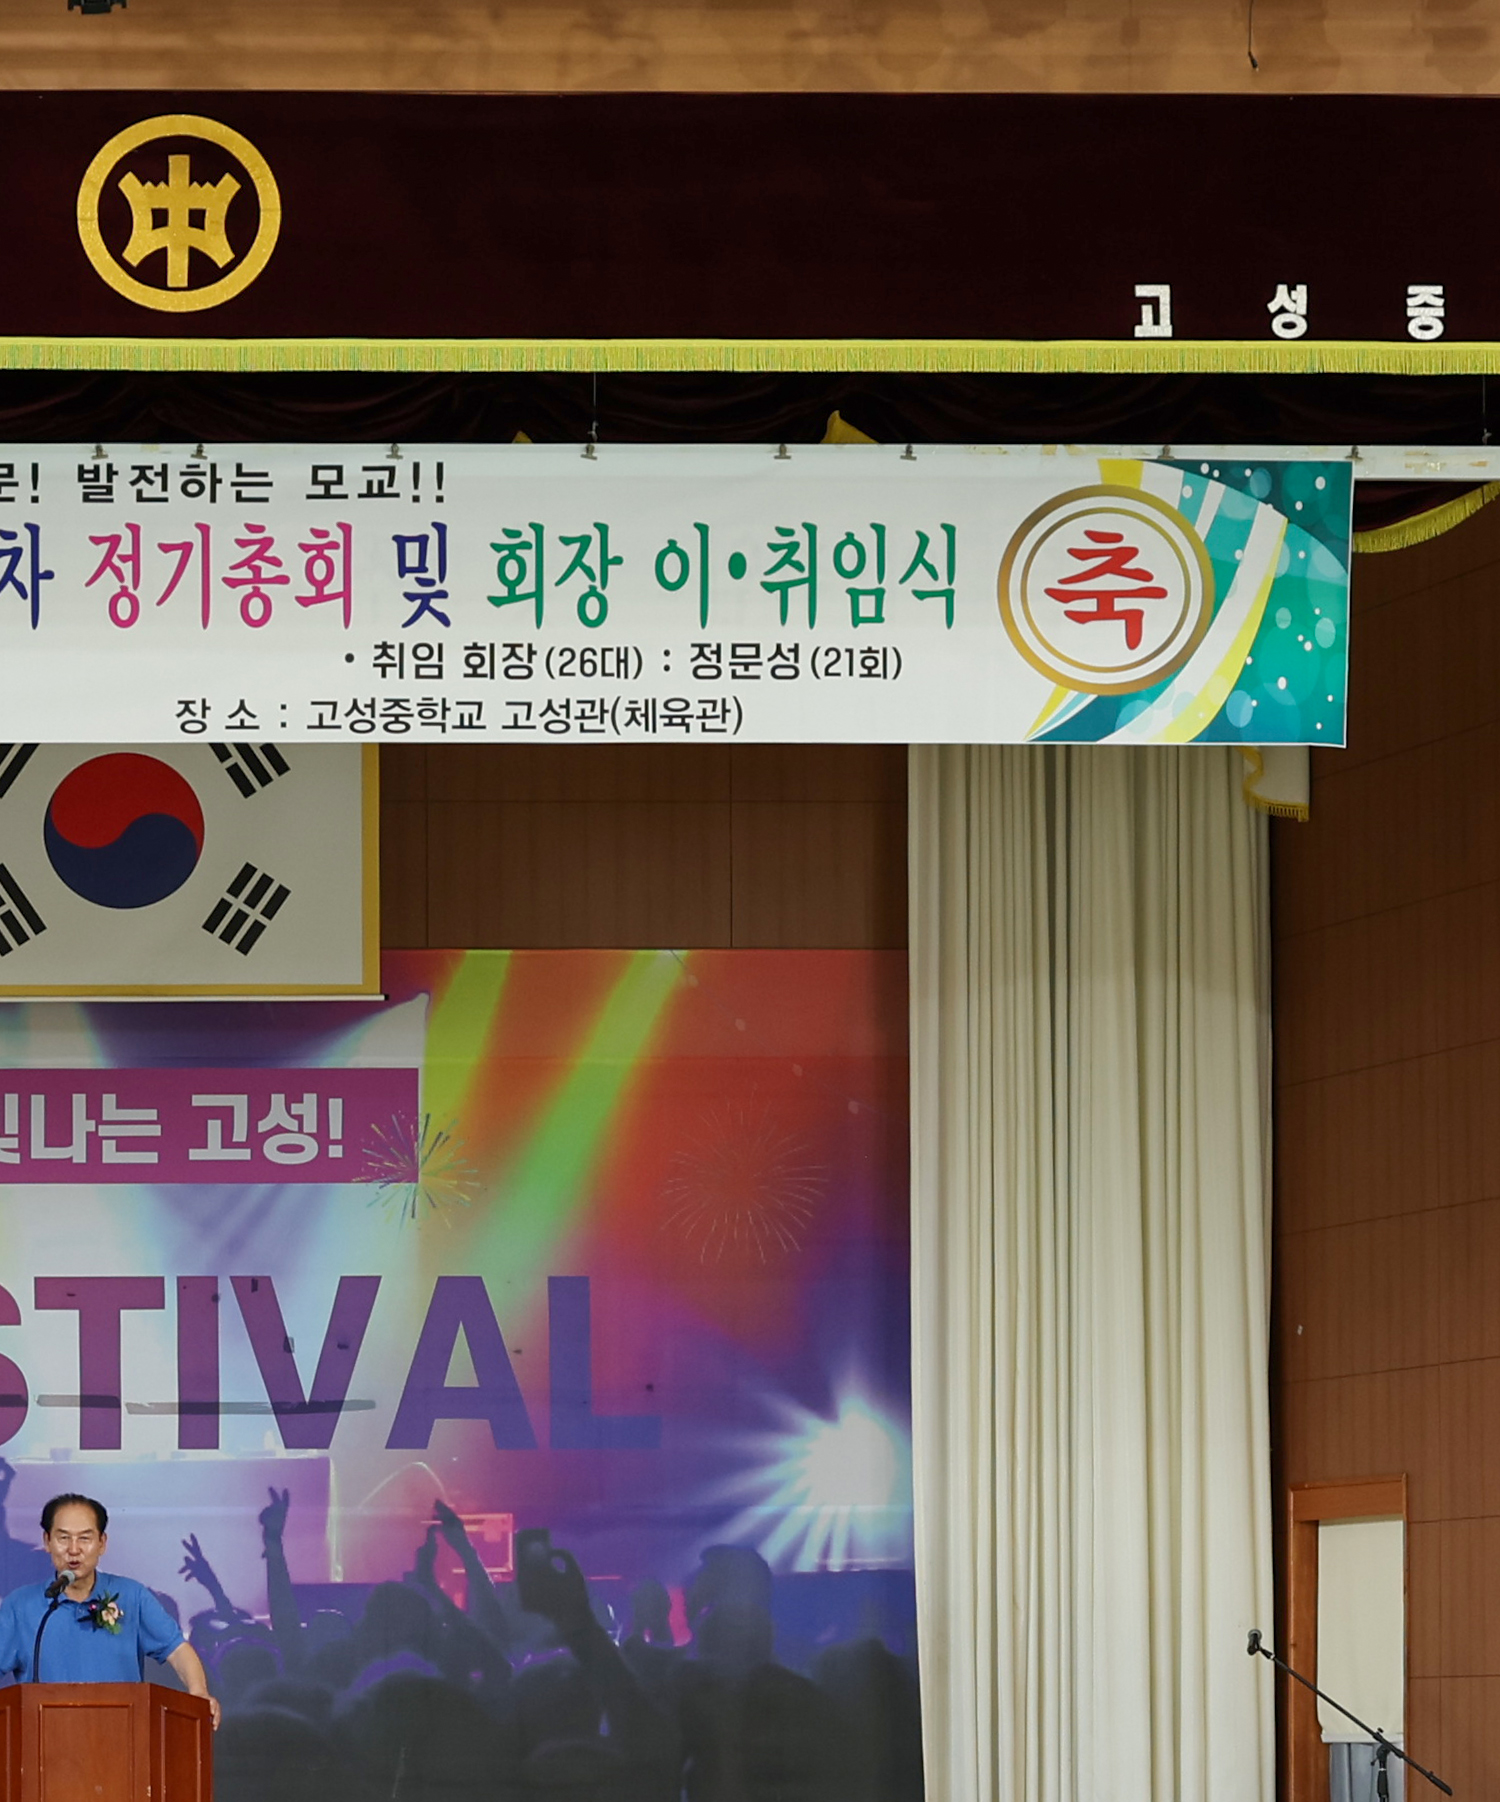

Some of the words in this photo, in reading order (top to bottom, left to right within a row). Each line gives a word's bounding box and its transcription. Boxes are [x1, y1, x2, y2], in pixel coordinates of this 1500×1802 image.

[78, 459, 273, 503] 발전하는
[306, 459, 447, 503] 모교!!
[85, 522, 352, 629] 정기총회
[392, 522, 450, 628] 및
[487, 522, 623, 629] 회장
[1047, 532, 1165, 647] 축
[373, 641, 443, 679] 취임
[463, 642, 642, 680] 회장(26대)
[307, 697, 486, 734] 고성중학교
[502, 696, 742, 735] 고성관(체육관)
[189, 1094, 345, 1165] 고성!
